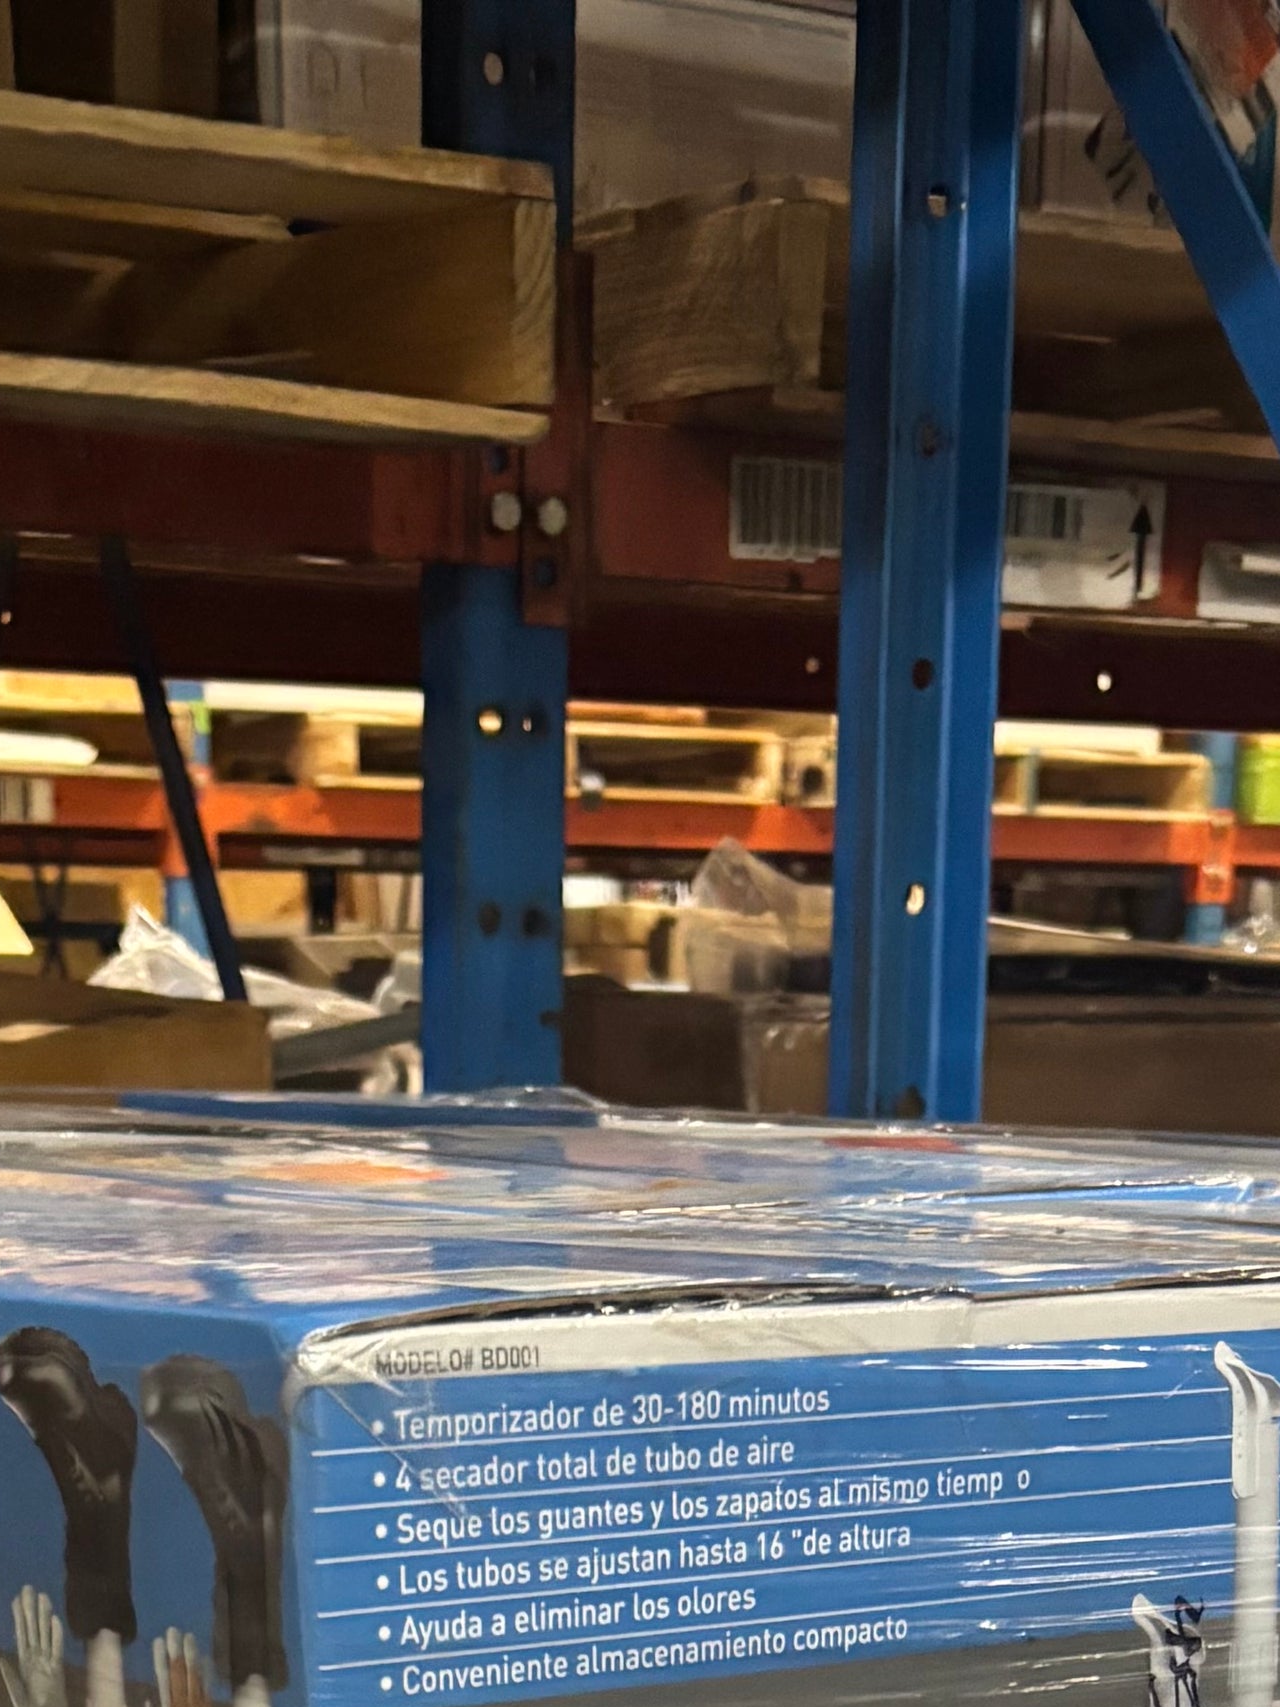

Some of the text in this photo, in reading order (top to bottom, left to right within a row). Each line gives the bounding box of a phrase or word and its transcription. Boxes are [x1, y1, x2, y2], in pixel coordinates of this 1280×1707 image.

[375, 1346, 541, 1377] MODELO# BD001
[394, 1388, 831, 1442] Temporizador de 30-180 minutos
[395, 1437, 796, 1492] 4 secador total de tubo de aire
[396, 1513, 484, 1551] Seque
[491, 1506, 531, 1538] los
[538, 1501, 645, 1540] guantes
[650, 1502, 665, 1530] y
[671, 1490, 710, 1521] los
[715, 1480, 813, 1522] zapatos
[818, 1479, 841, 1511] al
[848, 1468, 931, 1503] mismo
[399, 1564, 449, 1597] Los
[455, 1555, 532, 1590] tubos
[538, 1552, 570, 1582] se
[576, 1544, 673, 1585] ajustan
[679, 1536, 749, 1569] hasta
[756, 1531, 785, 1562] 16
[838, 1523, 912, 1555] altura
[400, 1586, 757, 1648] Ayuda a eliminar los olores
[402, 1618, 909, 1696] Conveniente almacenamiento compacto
